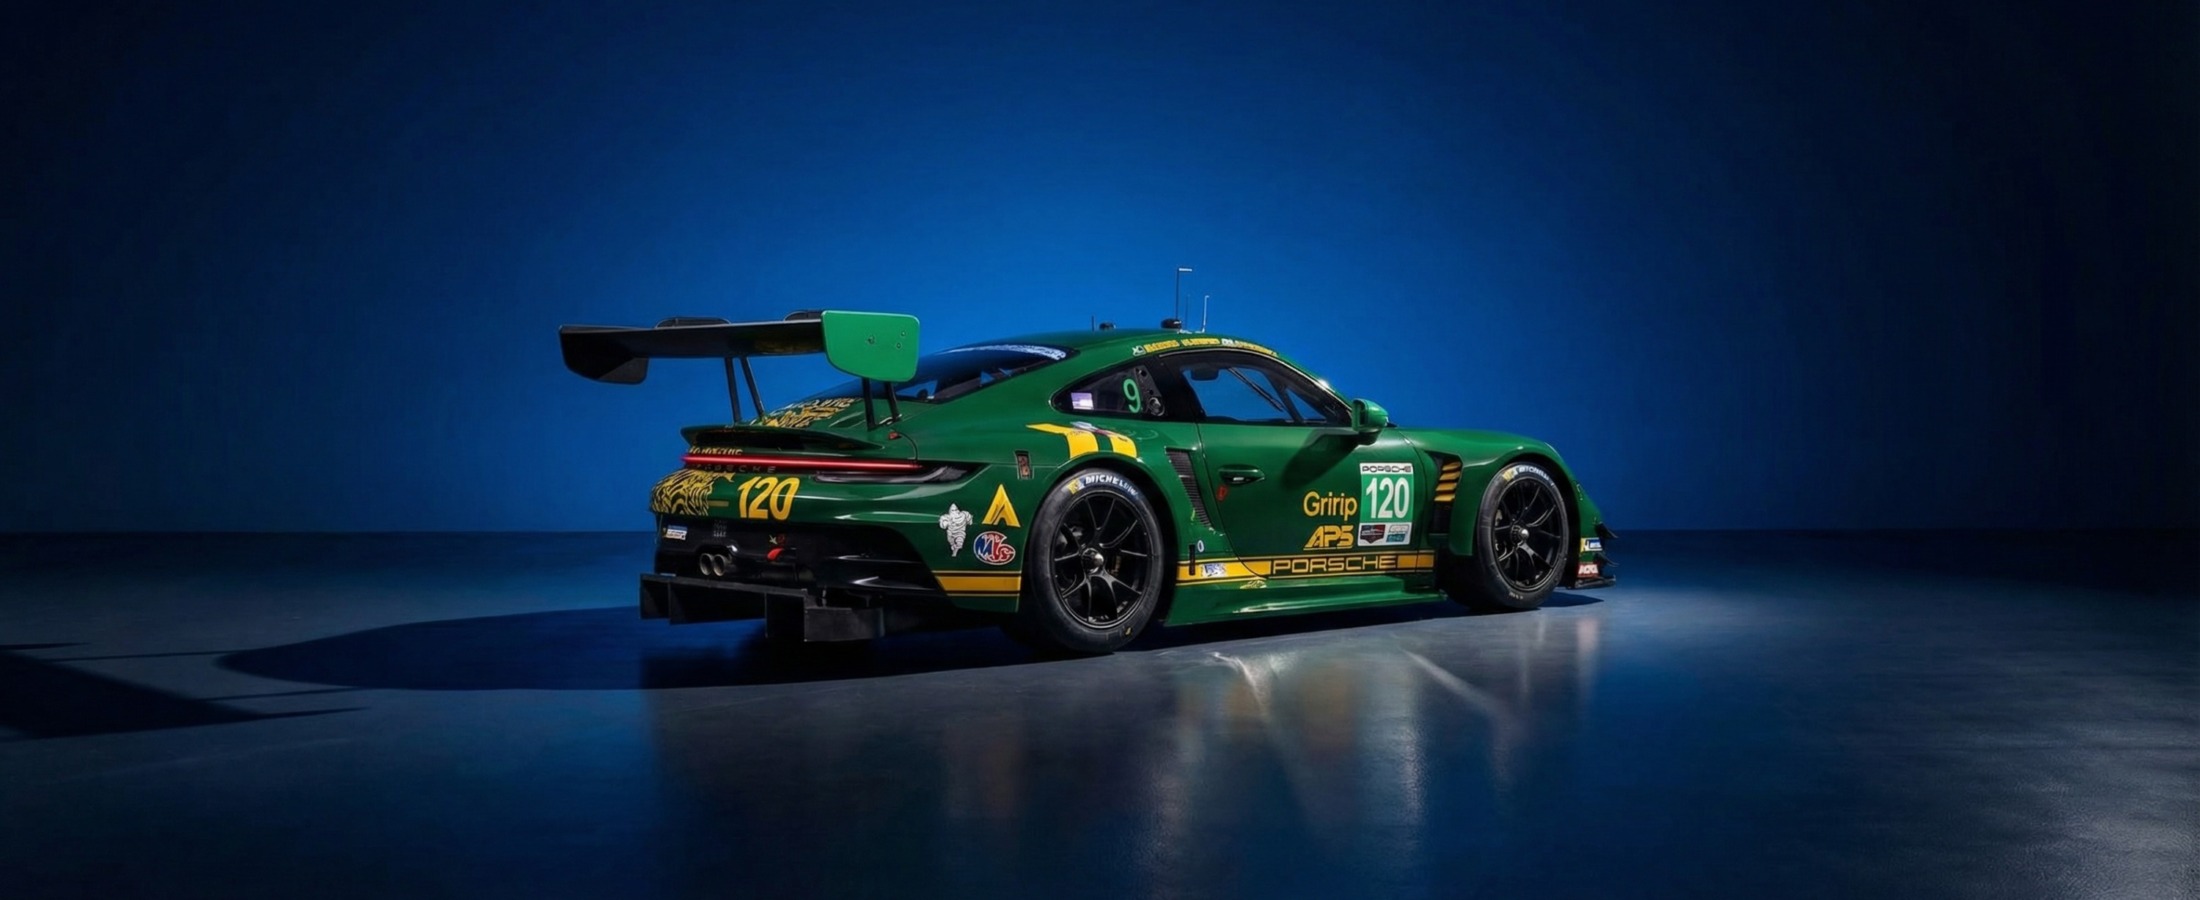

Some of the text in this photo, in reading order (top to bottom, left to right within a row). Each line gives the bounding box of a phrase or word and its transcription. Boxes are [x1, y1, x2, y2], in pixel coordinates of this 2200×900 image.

[1123, 378, 1141, 414] 9
[737, 476, 800, 520] 120
[1303, 491, 1358, 521] Gririp
[1365, 477, 1410, 519] 120
[1272, 555, 1397, 575] PORSCHE
